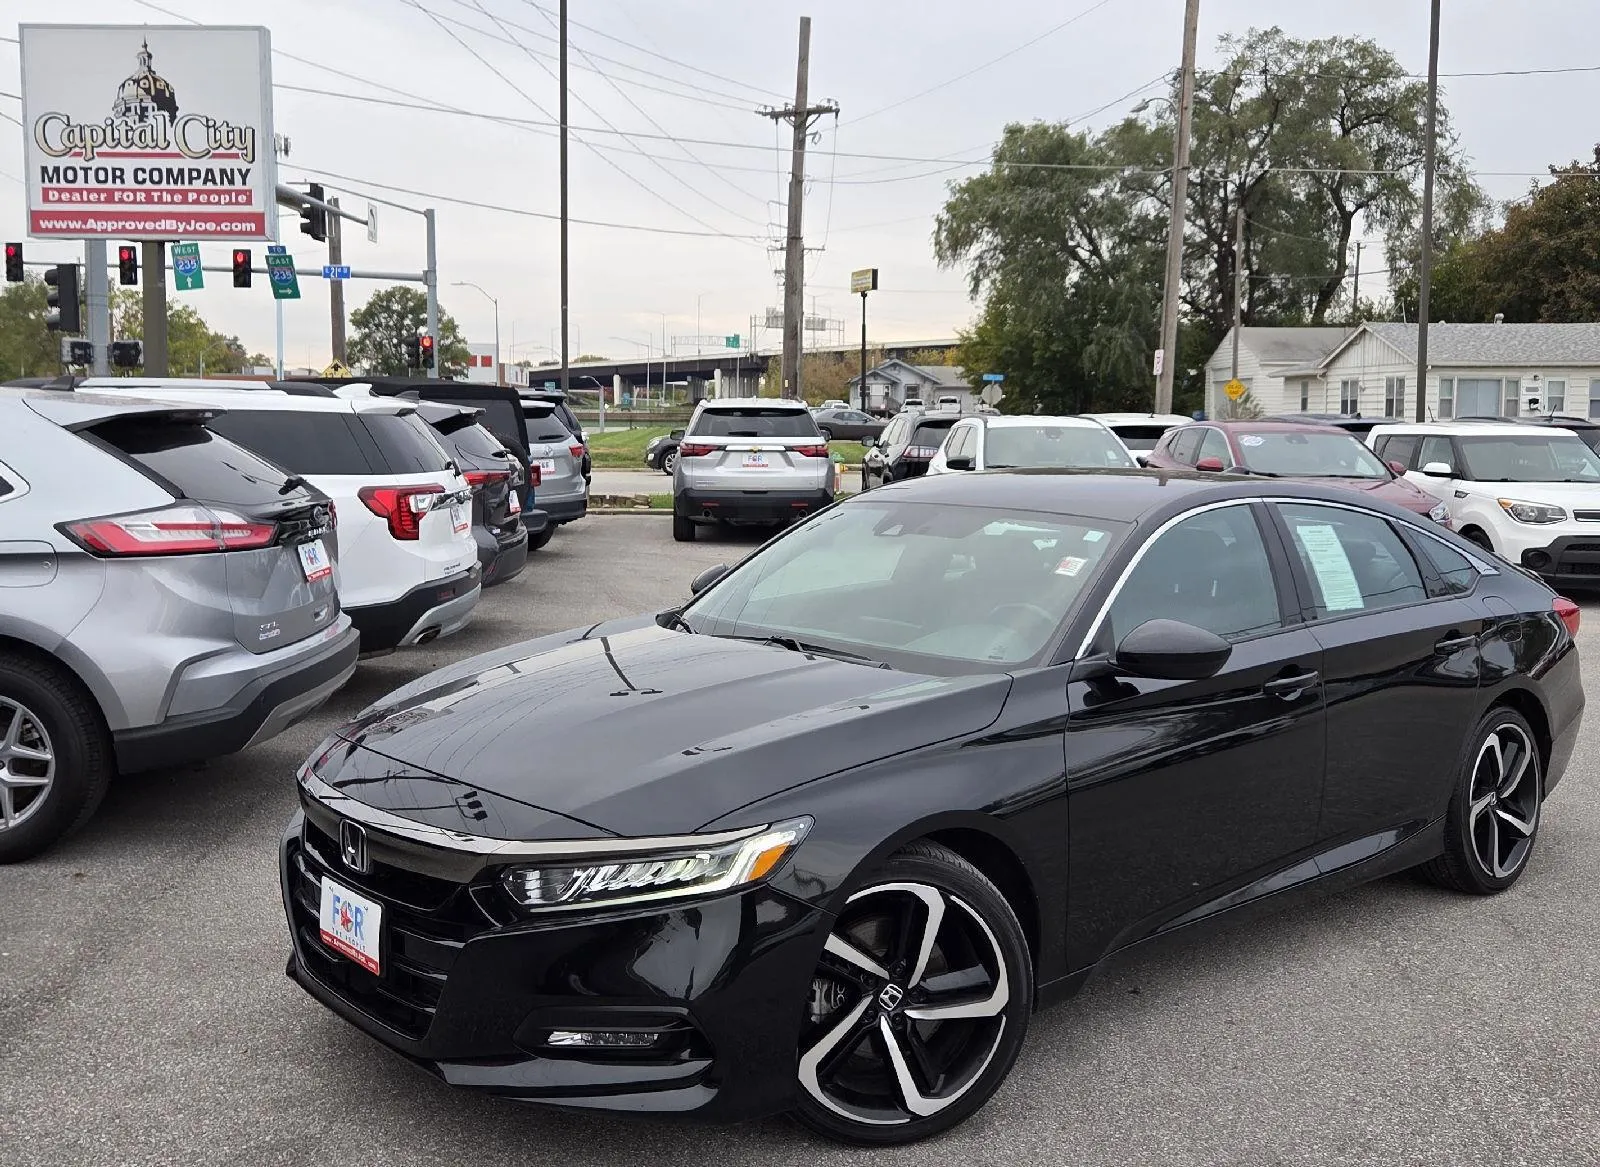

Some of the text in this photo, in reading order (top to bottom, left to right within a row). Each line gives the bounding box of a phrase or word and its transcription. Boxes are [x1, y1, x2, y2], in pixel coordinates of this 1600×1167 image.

[34, 111, 255, 164] Capital City
[40, 165, 251, 187] MOTOR COMPANY
[48, 190, 248, 205] Dealer FOR The People
[39, 218, 256, 233] www.ApprovedByJoe.com
[178, 259, 197, 270] 235
[273, 271, 293, 280] 235
[333, 895, 364, 940] FOR
